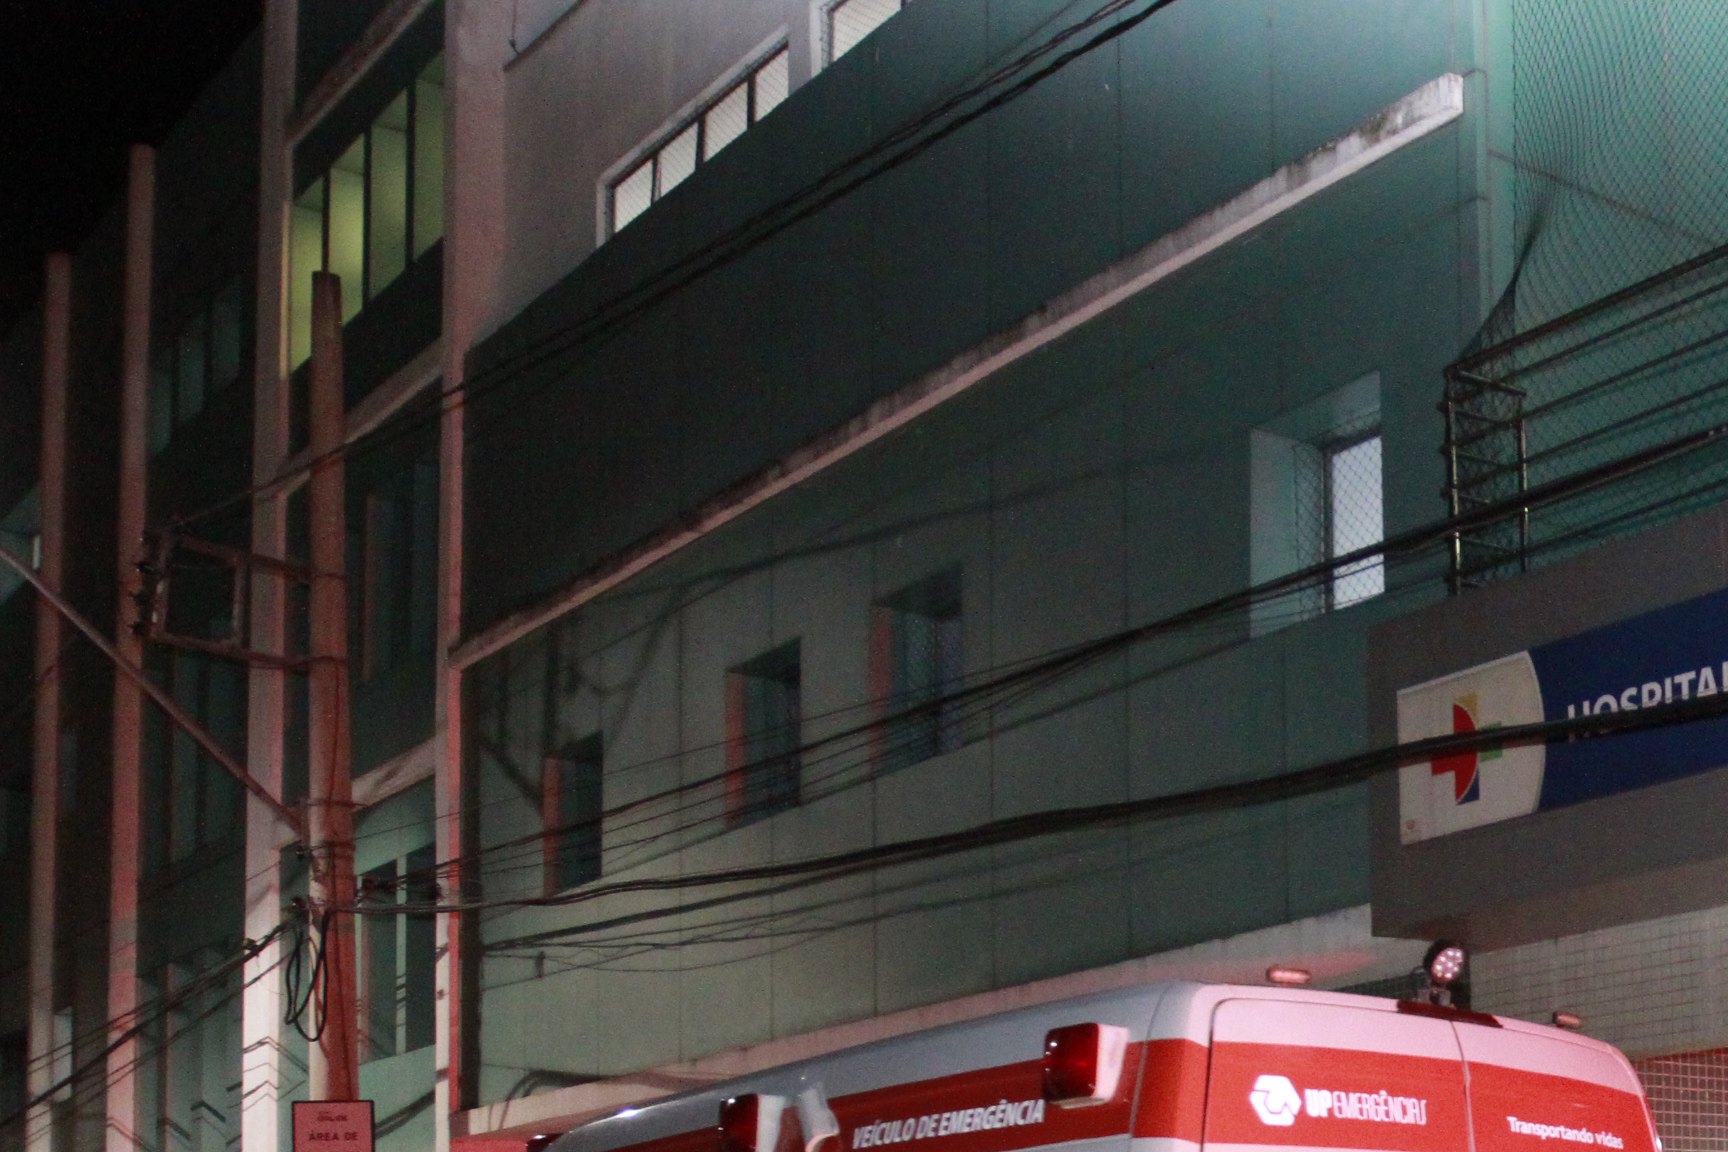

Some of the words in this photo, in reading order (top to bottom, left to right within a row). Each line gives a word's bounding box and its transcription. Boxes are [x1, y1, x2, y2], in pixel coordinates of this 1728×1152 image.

[344, 1131, 358, 1141] DE
[853, 1118, 915, 1149] VEÍCULO
[916, 1114, 939, 1139] DE
[939, 1099, 1045, 1136] EMERGÊNCIA
[1506, 1116, 1594, 1144] Transportando
[1595, 1131, 1624, 1150] vidas
